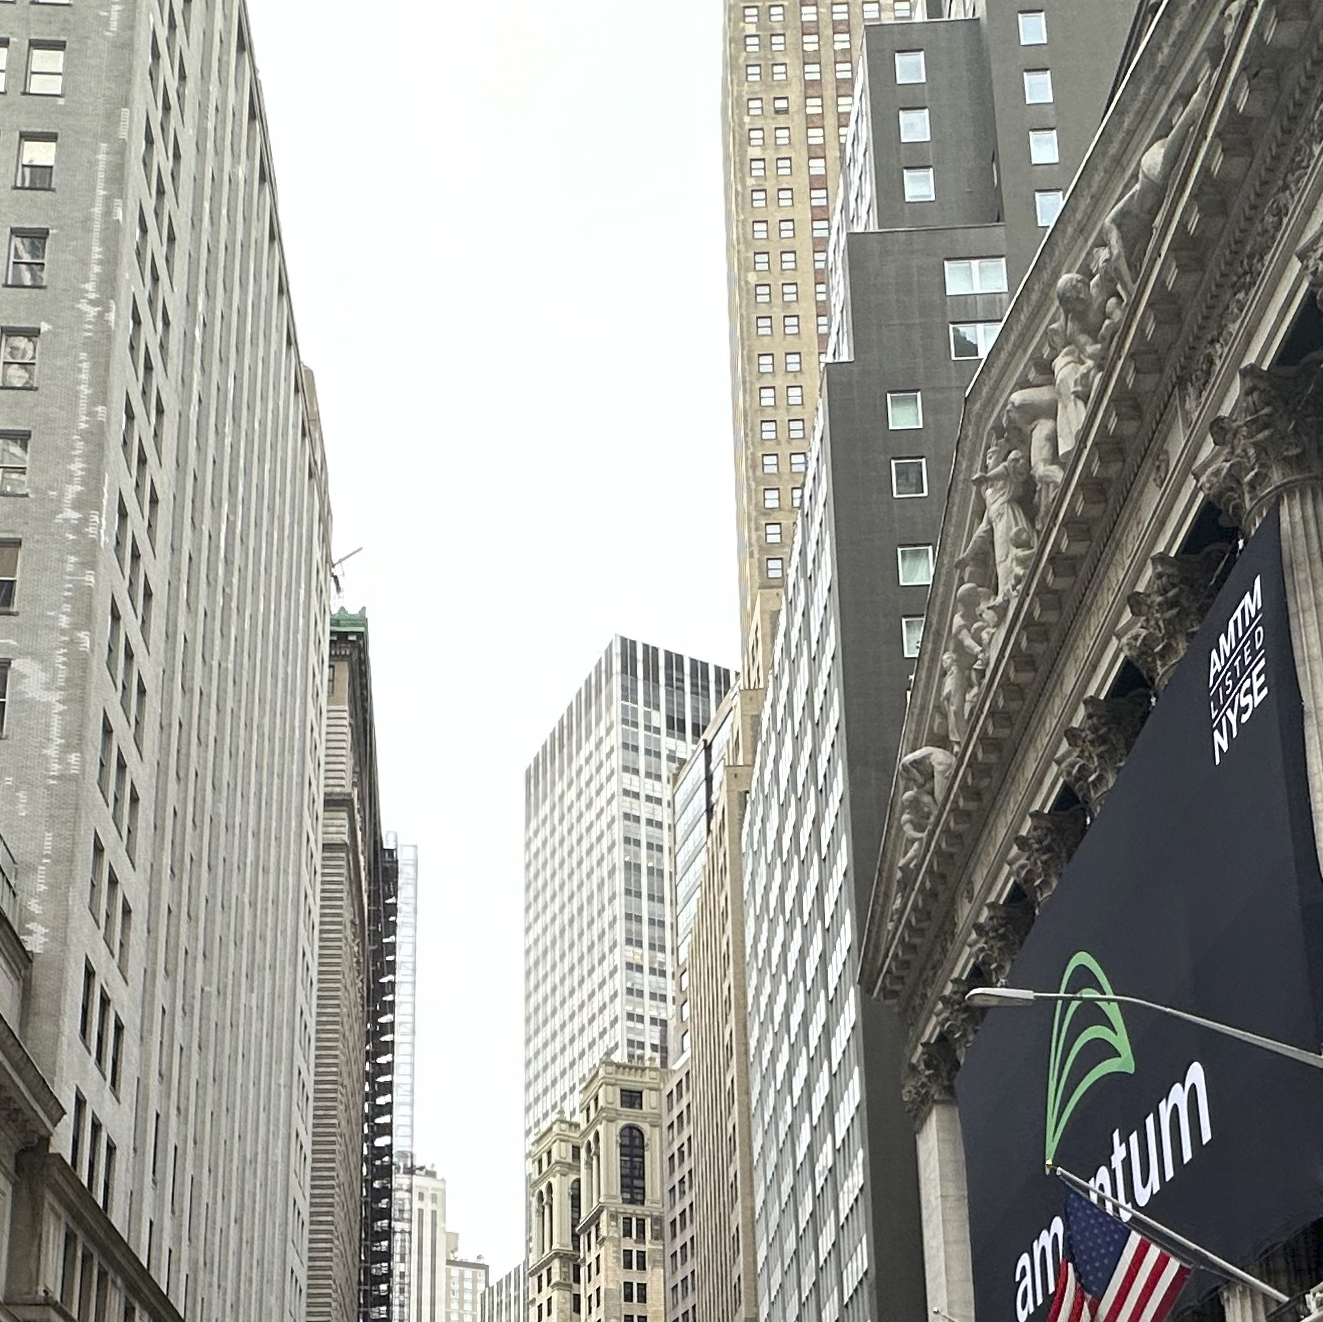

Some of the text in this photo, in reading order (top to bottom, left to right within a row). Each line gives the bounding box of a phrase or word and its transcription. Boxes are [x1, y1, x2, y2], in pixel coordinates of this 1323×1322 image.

[1208, 575, 1262, 687] AMTM
[1210, 626, 1264, 719] LISTED
[1212, 657, 1269, 766] NYSE
